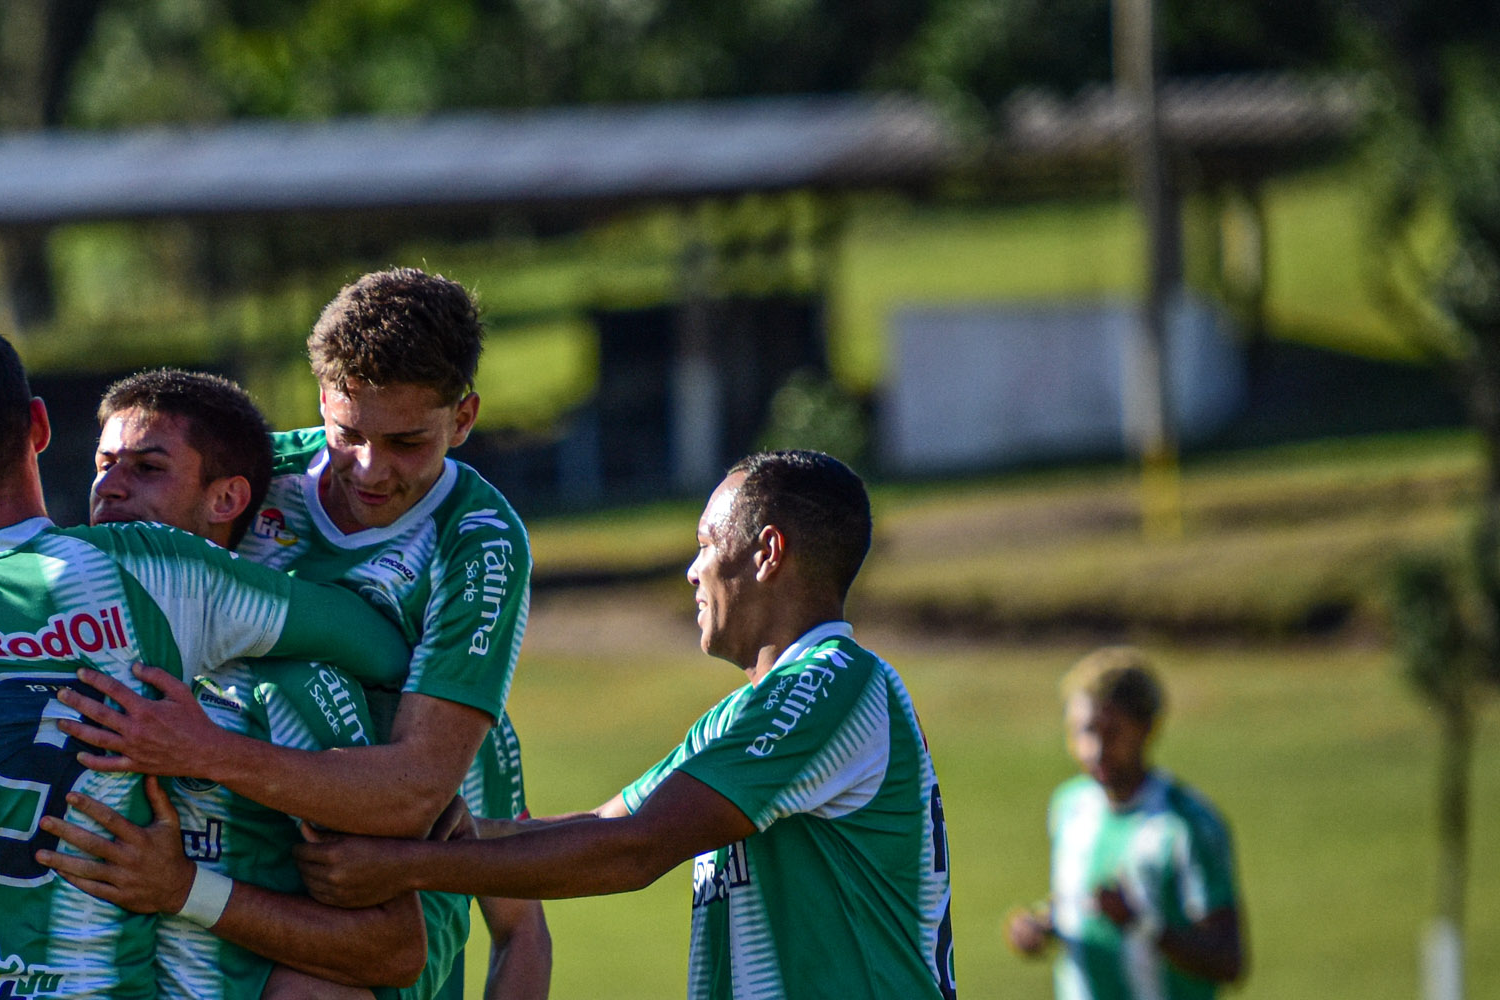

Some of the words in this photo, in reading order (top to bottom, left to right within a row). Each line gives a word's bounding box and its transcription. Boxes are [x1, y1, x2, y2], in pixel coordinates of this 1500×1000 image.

[468, 538, 514, 656] fátima
[309, 683, 341, 736] Saúde
[745, 664, 835, 757] fátima
